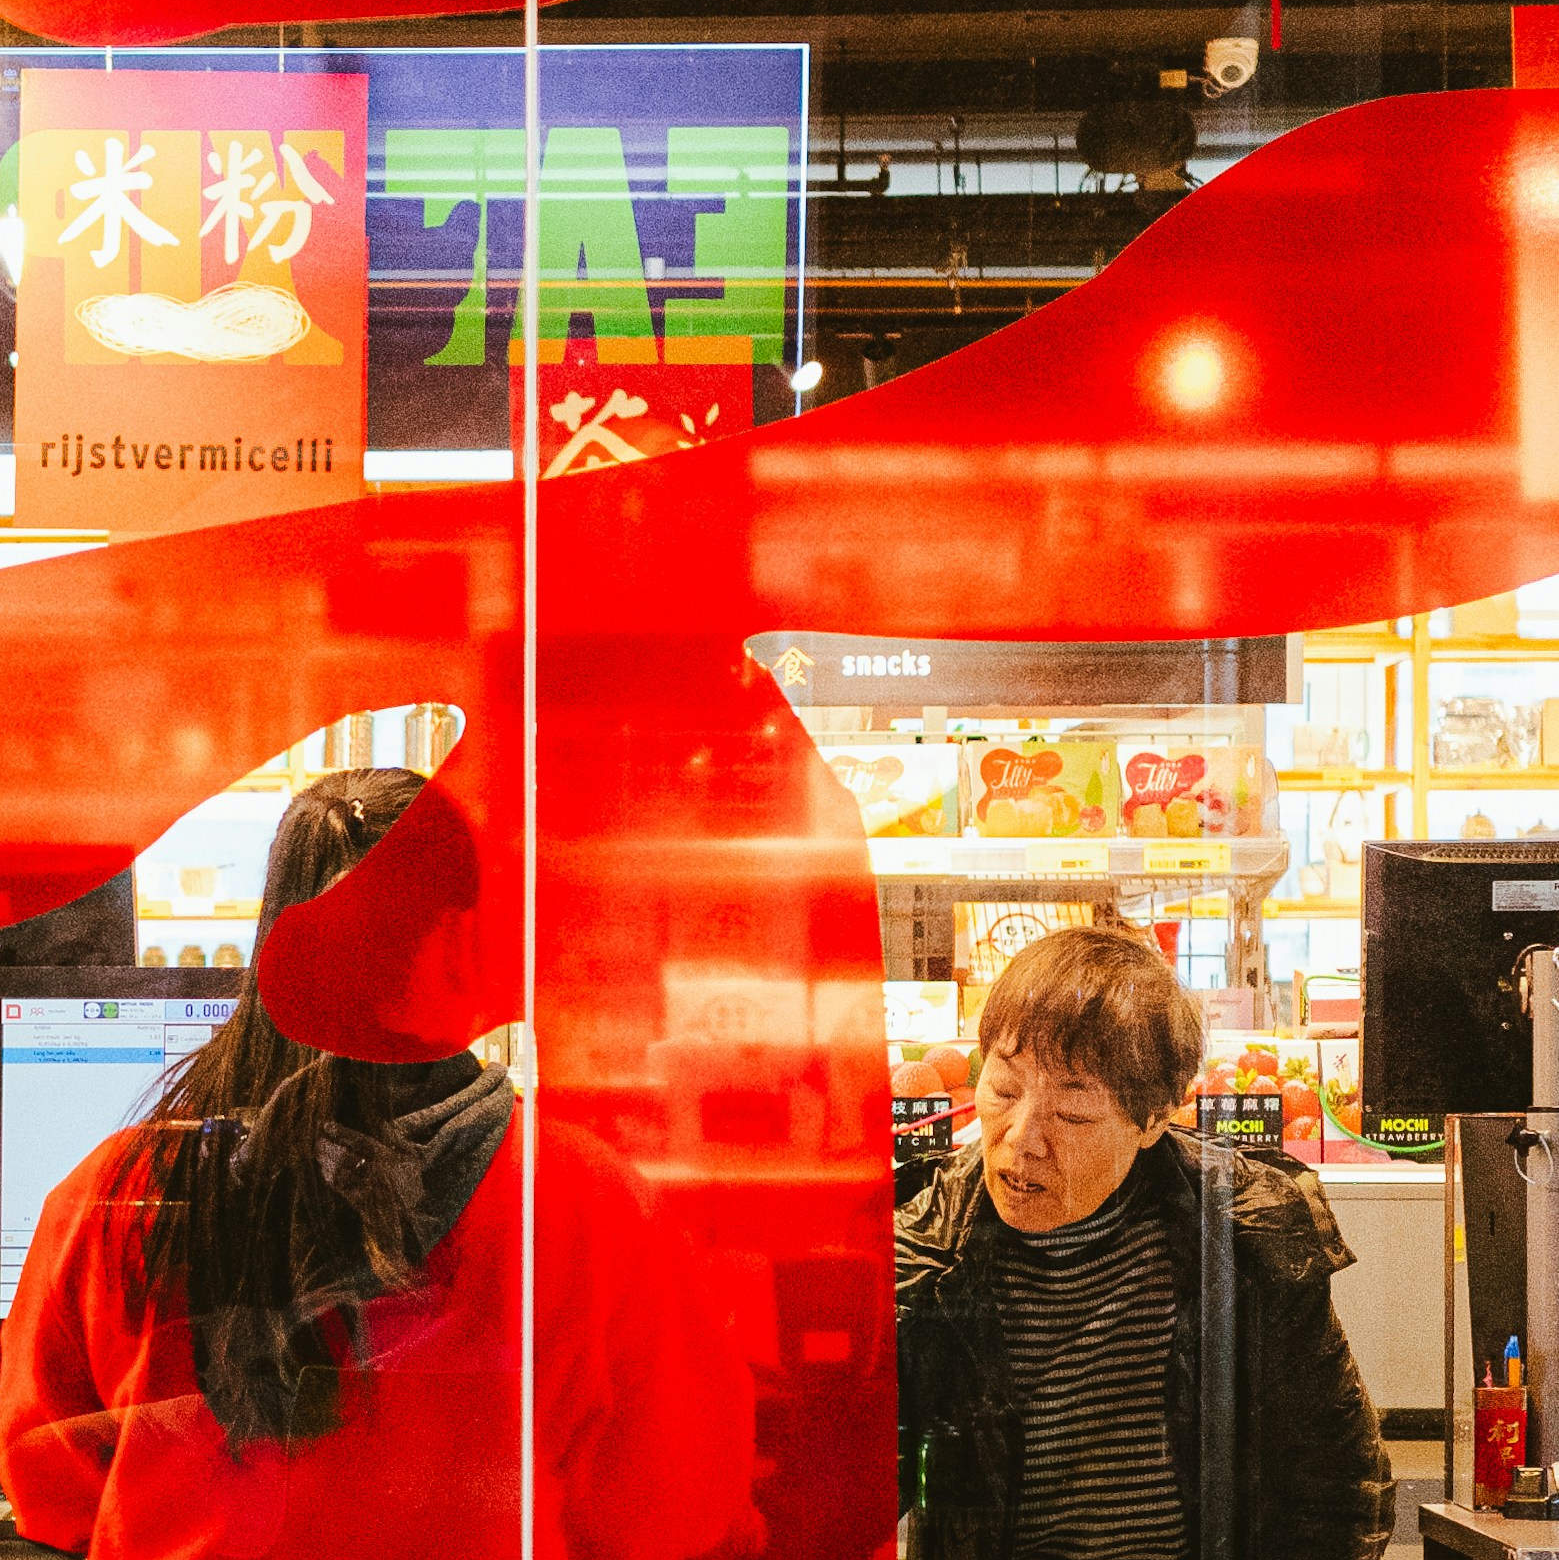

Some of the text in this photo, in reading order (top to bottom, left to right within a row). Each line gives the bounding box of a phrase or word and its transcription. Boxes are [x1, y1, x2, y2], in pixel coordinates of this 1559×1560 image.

[57, 136, 335, 269] 米粉
[39, 433, 334, 478] rijstvermicelli
[773, 646, 815, 687] 食
[841, 648, 932, 677] snacks
[892, 1121, 934, 1137] OCHI
[1215, 1119, 1265, 1134] MOCHI
[1380, 1118, 1429, 1133] MOCHI
